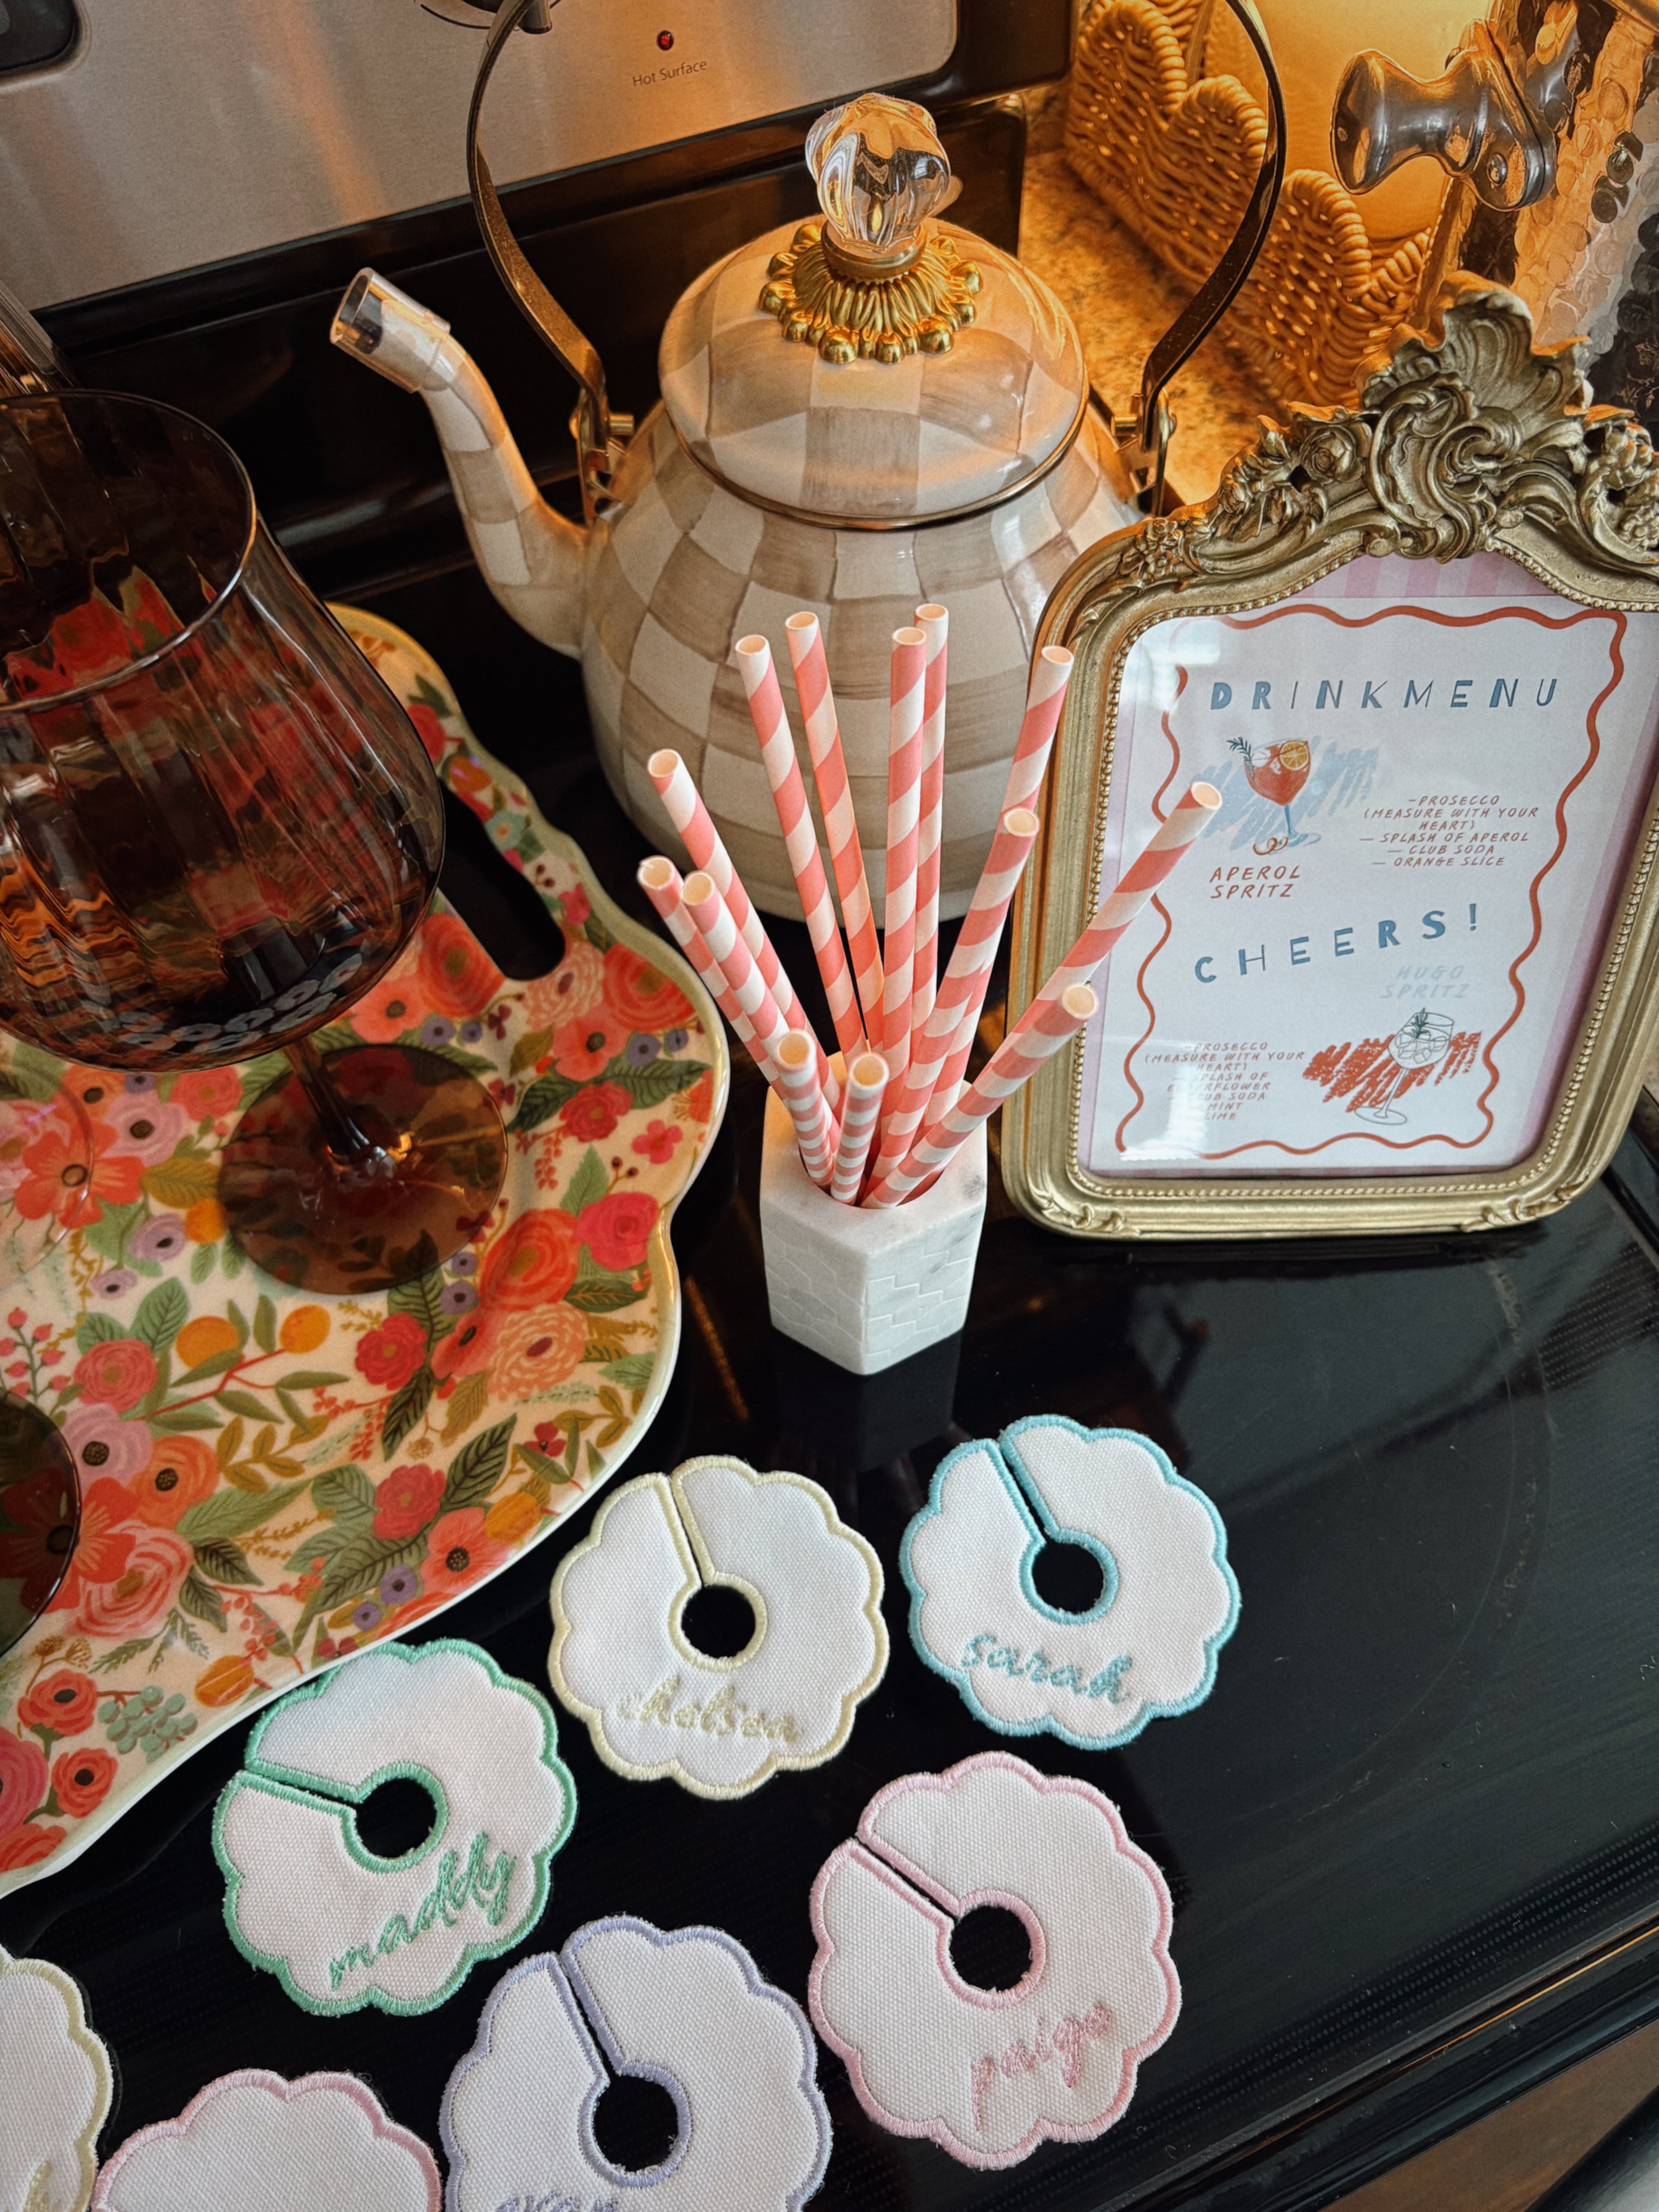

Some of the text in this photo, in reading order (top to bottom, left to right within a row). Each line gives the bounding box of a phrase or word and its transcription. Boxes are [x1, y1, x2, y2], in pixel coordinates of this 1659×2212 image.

[632, 61, 708, 87] Hot Surface
[1363, 807, 1539, 820] (MEASURE WITH YOUR
[1418, 820, 1475, 831] HEART)
[1380, 833, 1437, 844] SPLASH
[1444, 832, 1465, 843] OF
[1469, 832, 1529, 843] APEROL
[1408, 845, 1447, 855] CLUB
[1453, 845, 1495, 855] SODA
[1393, 857, 1455, 868] ORANGE
[1460, 856, 1505, 867] SLICE
[1209, 866, 1301, 884] APEROL
[1210, 884, 1294, 899] SPRITZ
[1194, 903, 1477, 984] CHEERS!
[1395, 965, 1465, 981] HUGO
[1379, 983, 1470, 1000] SPRITZ
[1145, 1051, 1306, 1064] (MEASURE WITH YOUR
[1196, 1062, 1248, 1072] HEART)
[1250, 1071, 1269, 1081] OF
[1167, 1081, 1271, 1093] ERFLOWER
[1228, 1092, 1265, 1102] SODA
[1207, 1102, 1243, 1111] MINT
[1204, 1112, 1237, 1121] LIME
[329, 1831, 518, 1992] maddy
